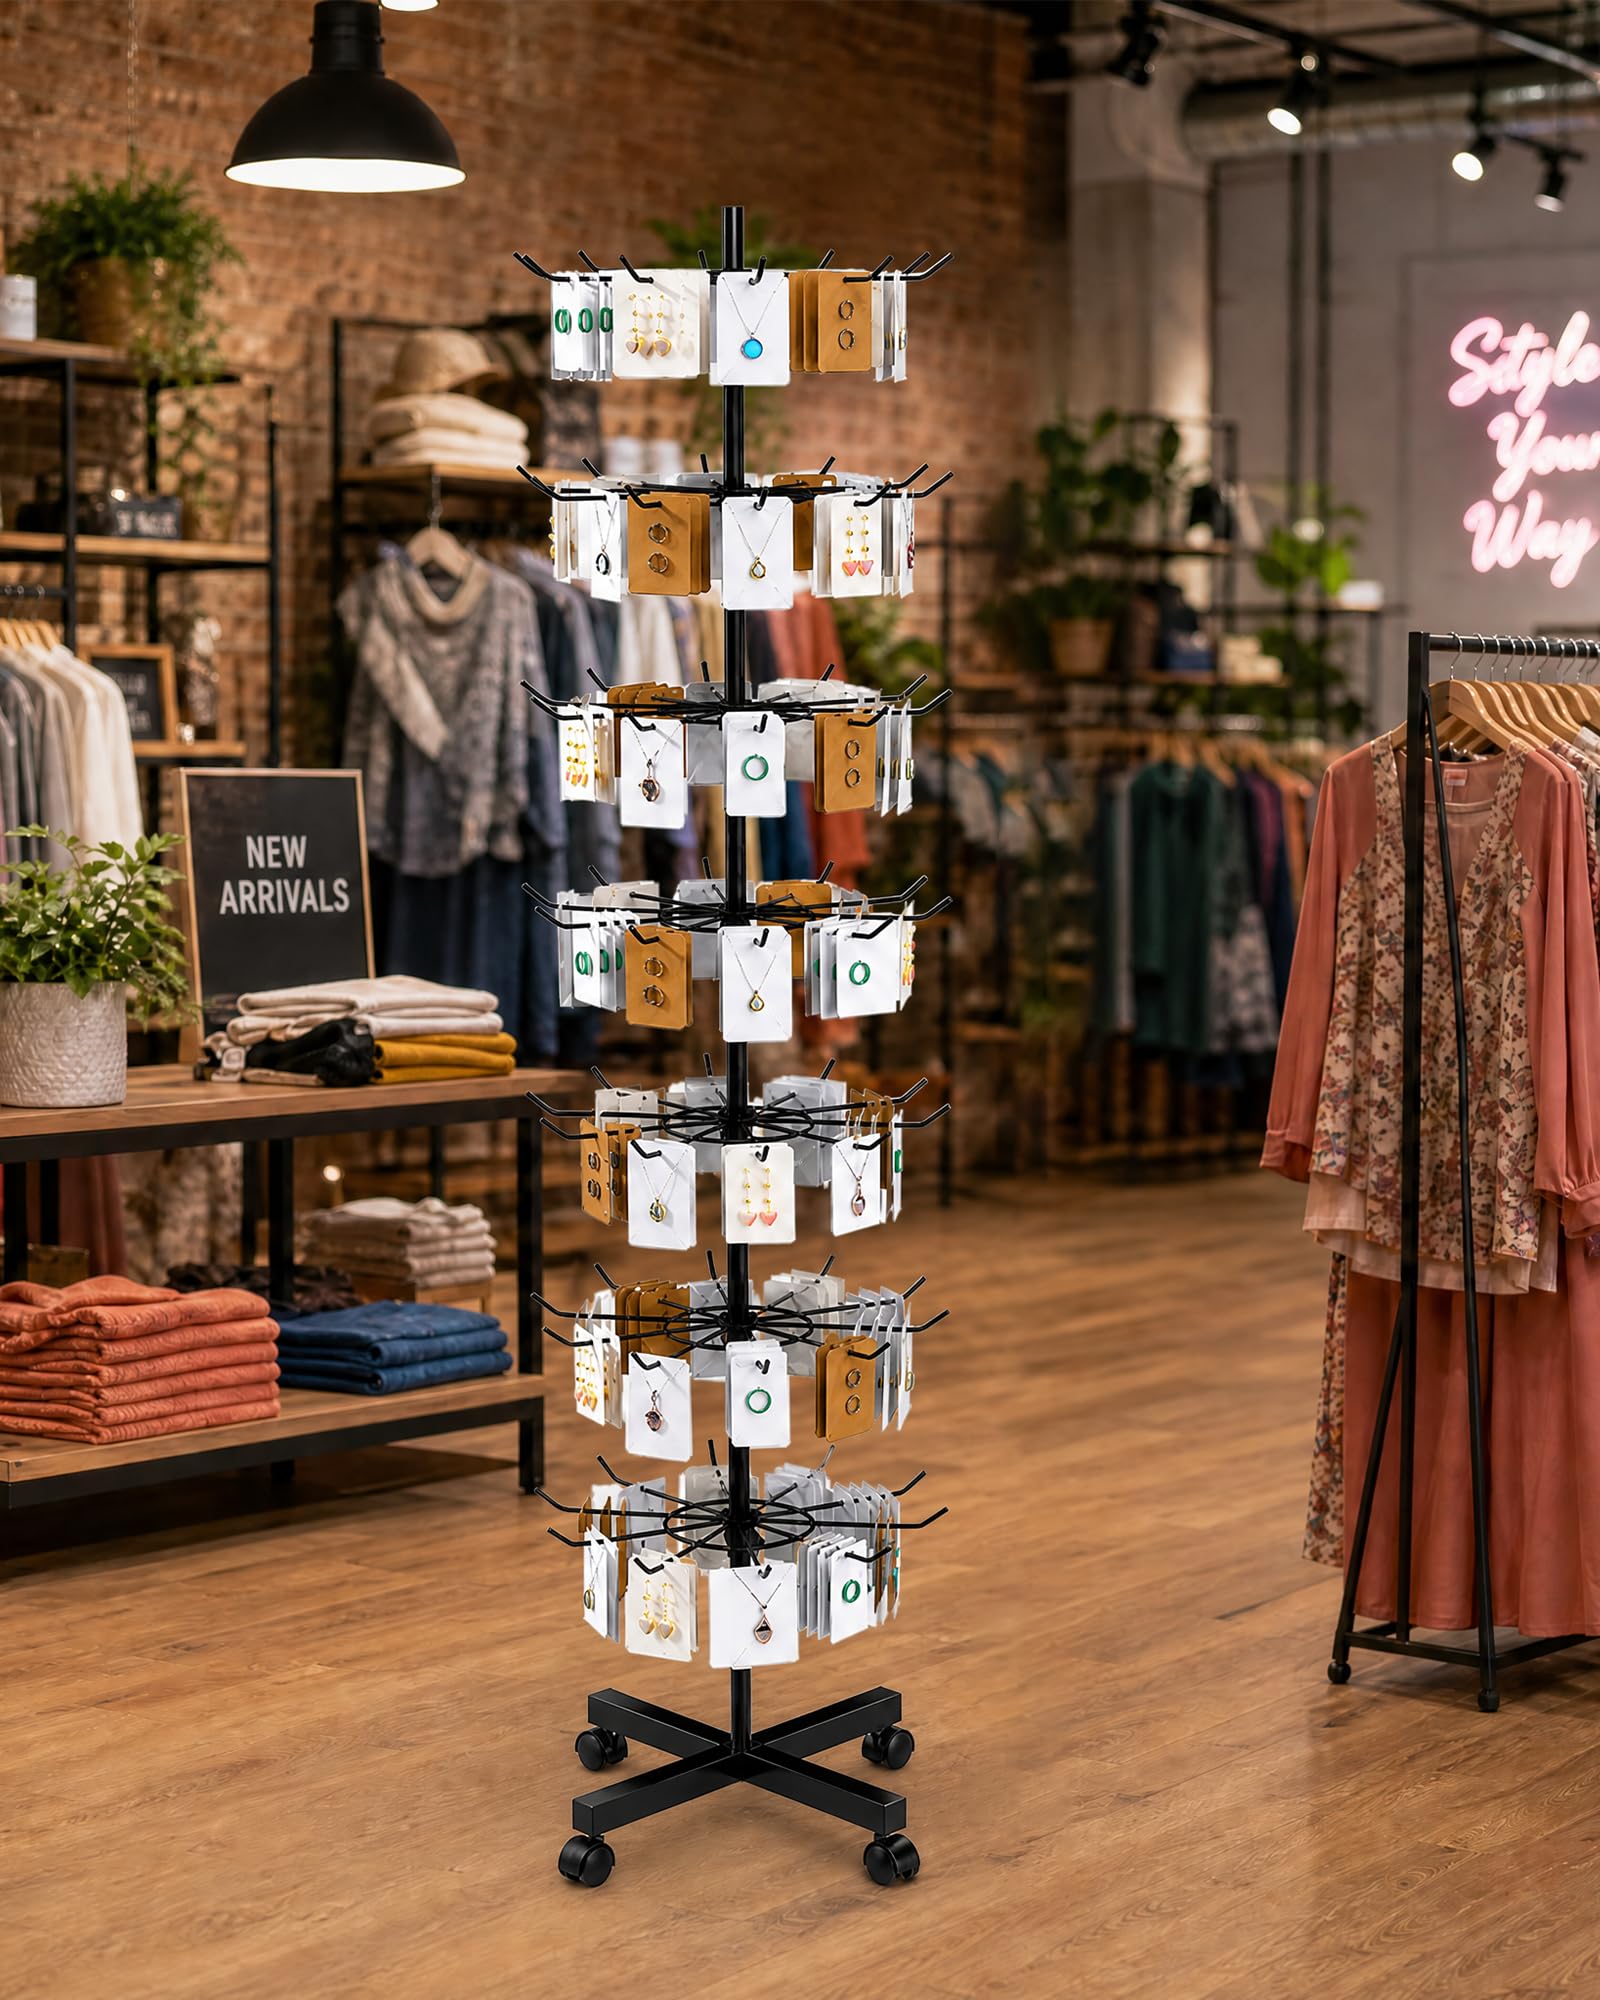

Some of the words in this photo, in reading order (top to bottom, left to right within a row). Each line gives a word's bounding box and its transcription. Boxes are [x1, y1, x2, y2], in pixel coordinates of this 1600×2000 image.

[1448, 310, 1600, 418] Style
[1463, 489, 1600, 589] Way
[246, 835, 307, 869] NEW
[219, 877, 350, 915] ARRIVALS
